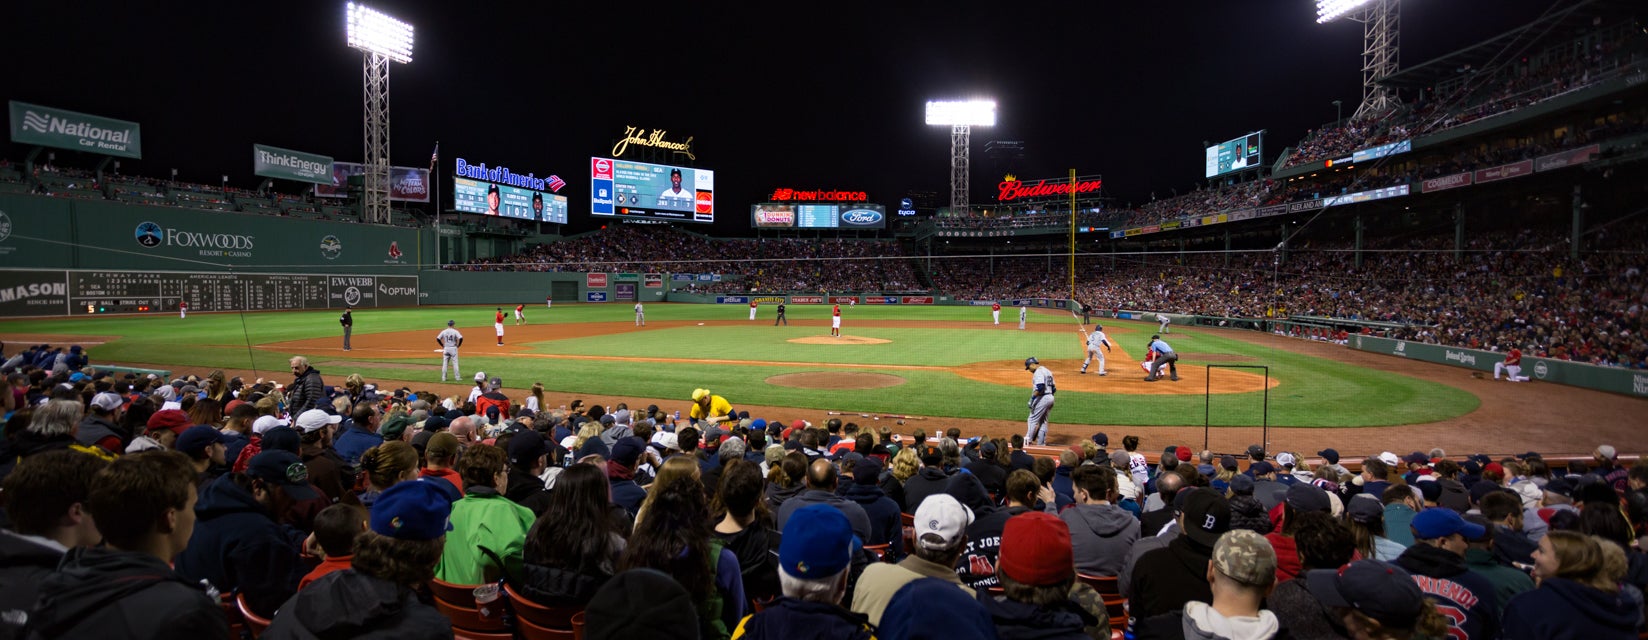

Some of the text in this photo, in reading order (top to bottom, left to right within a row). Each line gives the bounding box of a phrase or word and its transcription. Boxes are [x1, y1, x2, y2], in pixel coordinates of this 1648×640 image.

[49, 117, 129, 144] National
[79, 138, 126, 151] Car Rental
[612, 125, 696, 160] John Hancock
[456, 158, 489, 180] Bank
[489, 166, 502, 182] of
[502, 168, 544, 191] America
[793, 191, 817, 201] new
[817, 188, 867, 201] balance
[998, 179, 1102, 201] Budweiser
[514, 207, 519, 216] 0
[522, 208, 528, 217] 2
[849, 211, 874, 222] Ford
[166, 228, 255, 250] FOXWOODS
[348, 277, 373, 287] WEBB
[388, 287, 416, 296] OPTUM
[87, 304, 95, 314] 5
[1202, 513, 1216, 529] B
